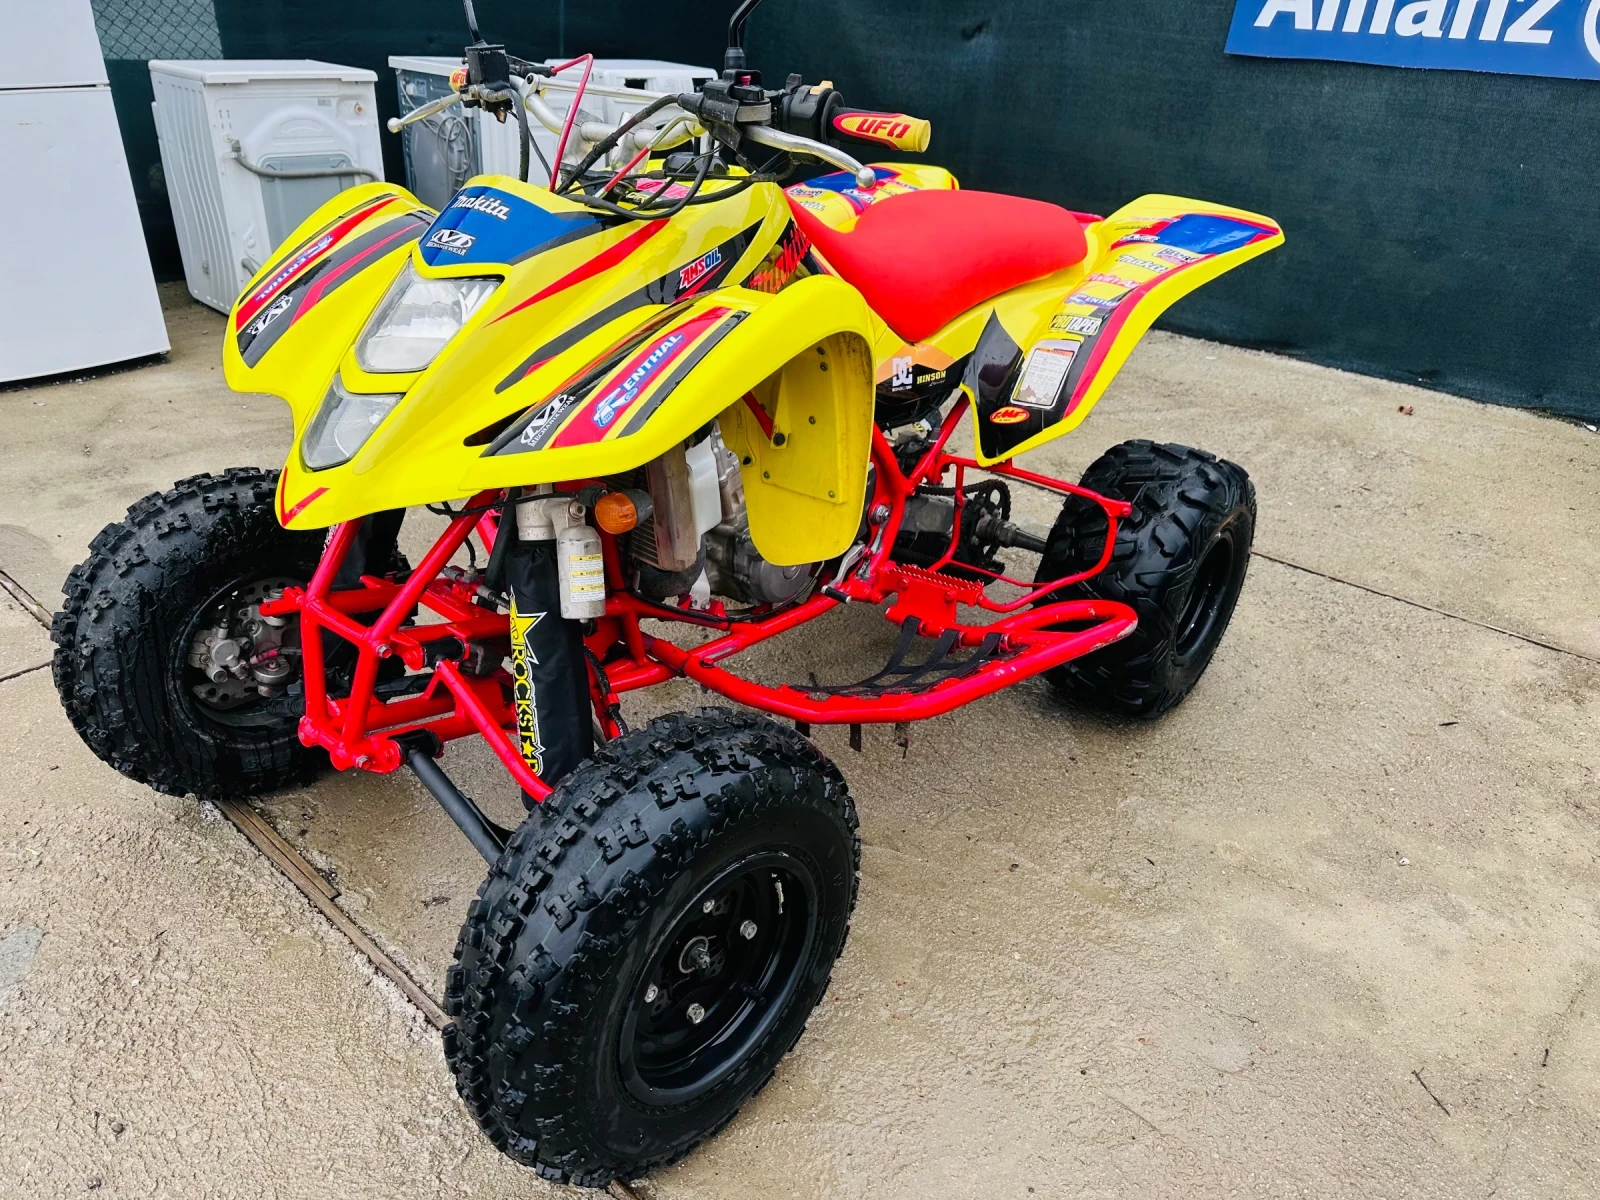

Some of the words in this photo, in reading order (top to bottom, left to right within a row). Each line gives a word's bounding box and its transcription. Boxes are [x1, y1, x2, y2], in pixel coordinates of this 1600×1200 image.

[855, 118, 911, 138] UFO
[680, 249, 721, 288] AMSOIL
[917, 371, 946, 384] HINSON
[528, 411, 560, 447] MECHANIX
[558, 395, 577, 417] WEAR
